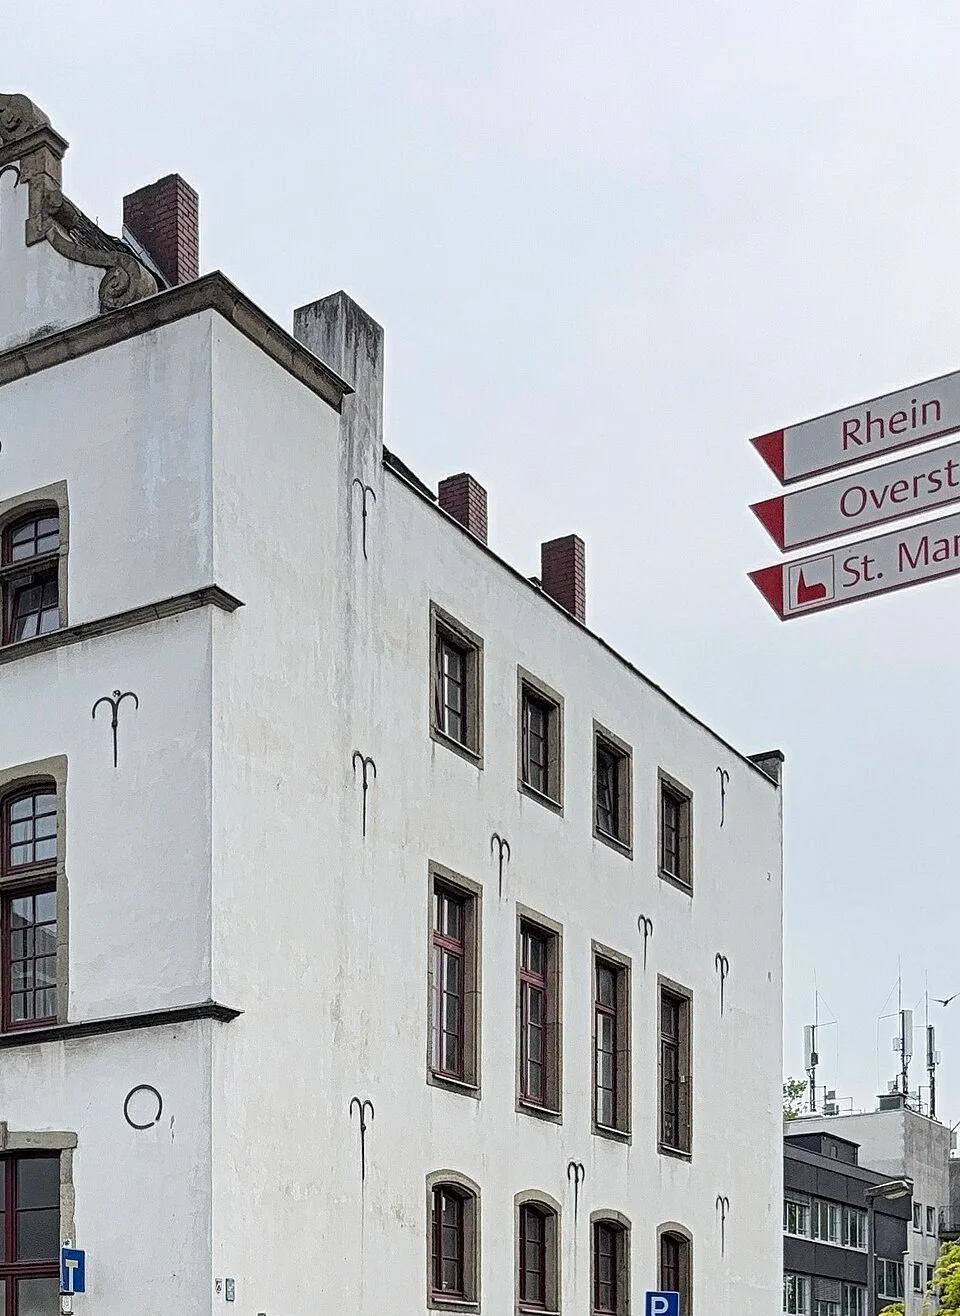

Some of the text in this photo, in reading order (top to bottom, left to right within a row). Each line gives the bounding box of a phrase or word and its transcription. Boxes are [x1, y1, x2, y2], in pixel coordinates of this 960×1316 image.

[842, 398, 941, 450] Rhein
[839, 458, 960, 518] Overst
[842, 554, 883, 588] St.
